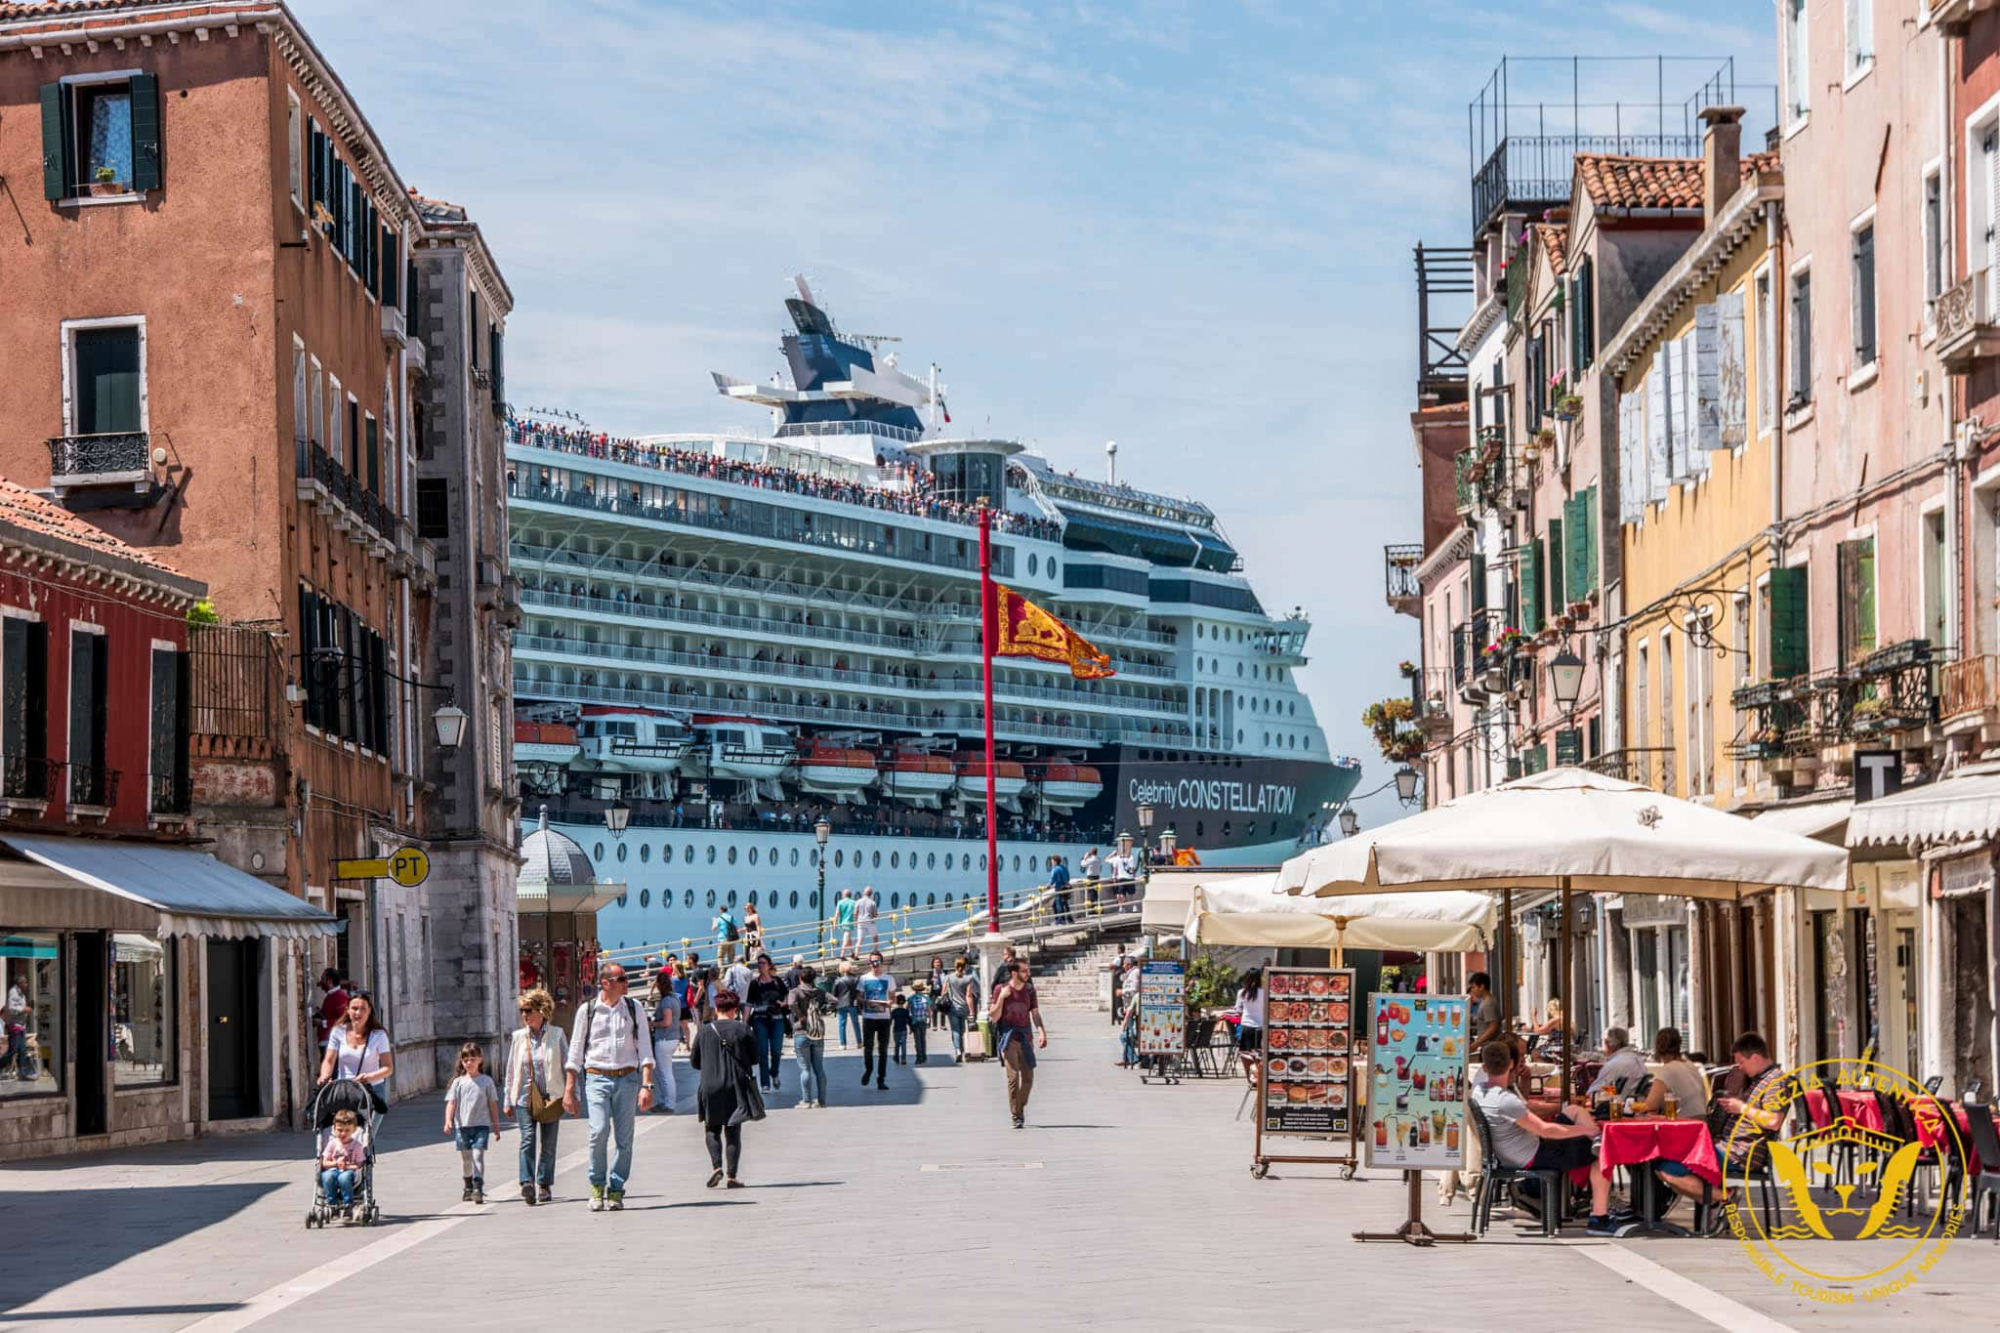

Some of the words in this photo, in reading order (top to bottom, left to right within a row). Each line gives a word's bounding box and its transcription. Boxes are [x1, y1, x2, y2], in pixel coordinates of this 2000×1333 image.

[1860, 755, 1895, 800] T
[1129, 778, 1177, 809] Celebrity
[1179, 778, 1296, 814] CONSTELLATION
[395, 857, 420, 877] PT
